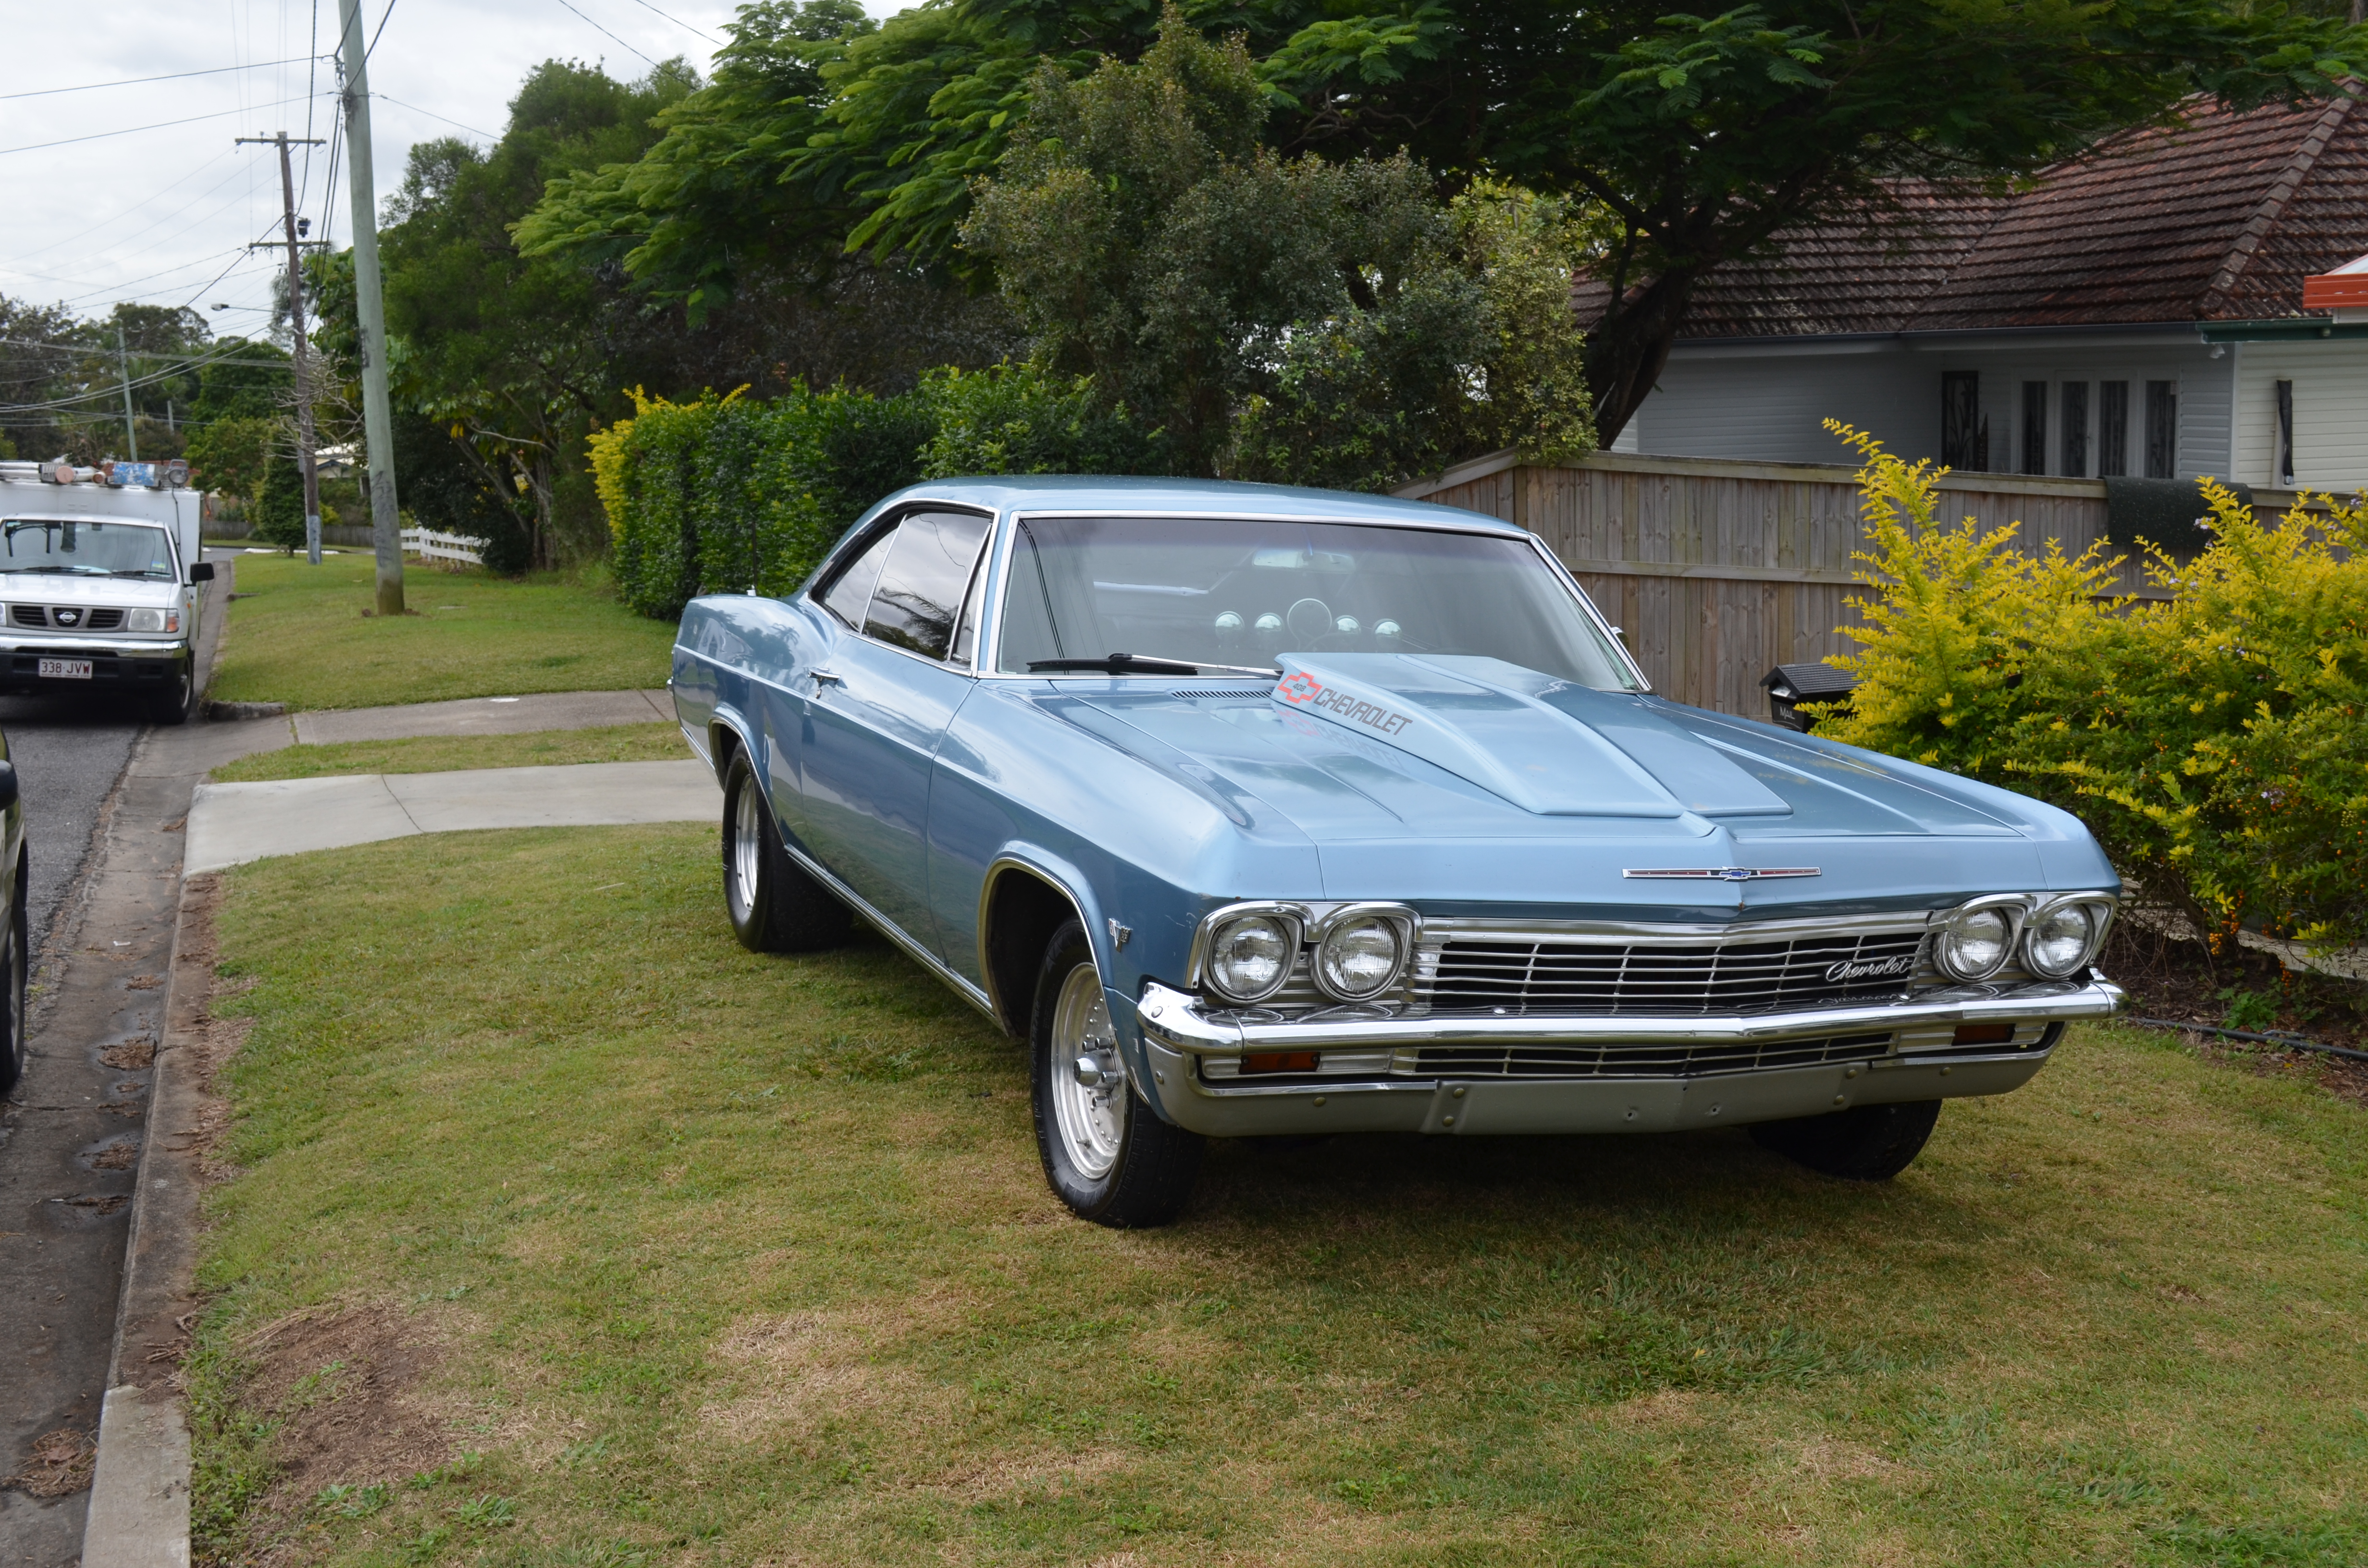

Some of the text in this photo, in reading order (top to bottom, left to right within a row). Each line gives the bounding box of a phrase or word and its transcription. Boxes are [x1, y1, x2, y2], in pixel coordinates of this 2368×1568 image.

[1293, 683, 1306, 692] 408
[1313, 687, 1413, 735] CHEVROLET
[1825, 956, 1913, 982] Chevrolet
